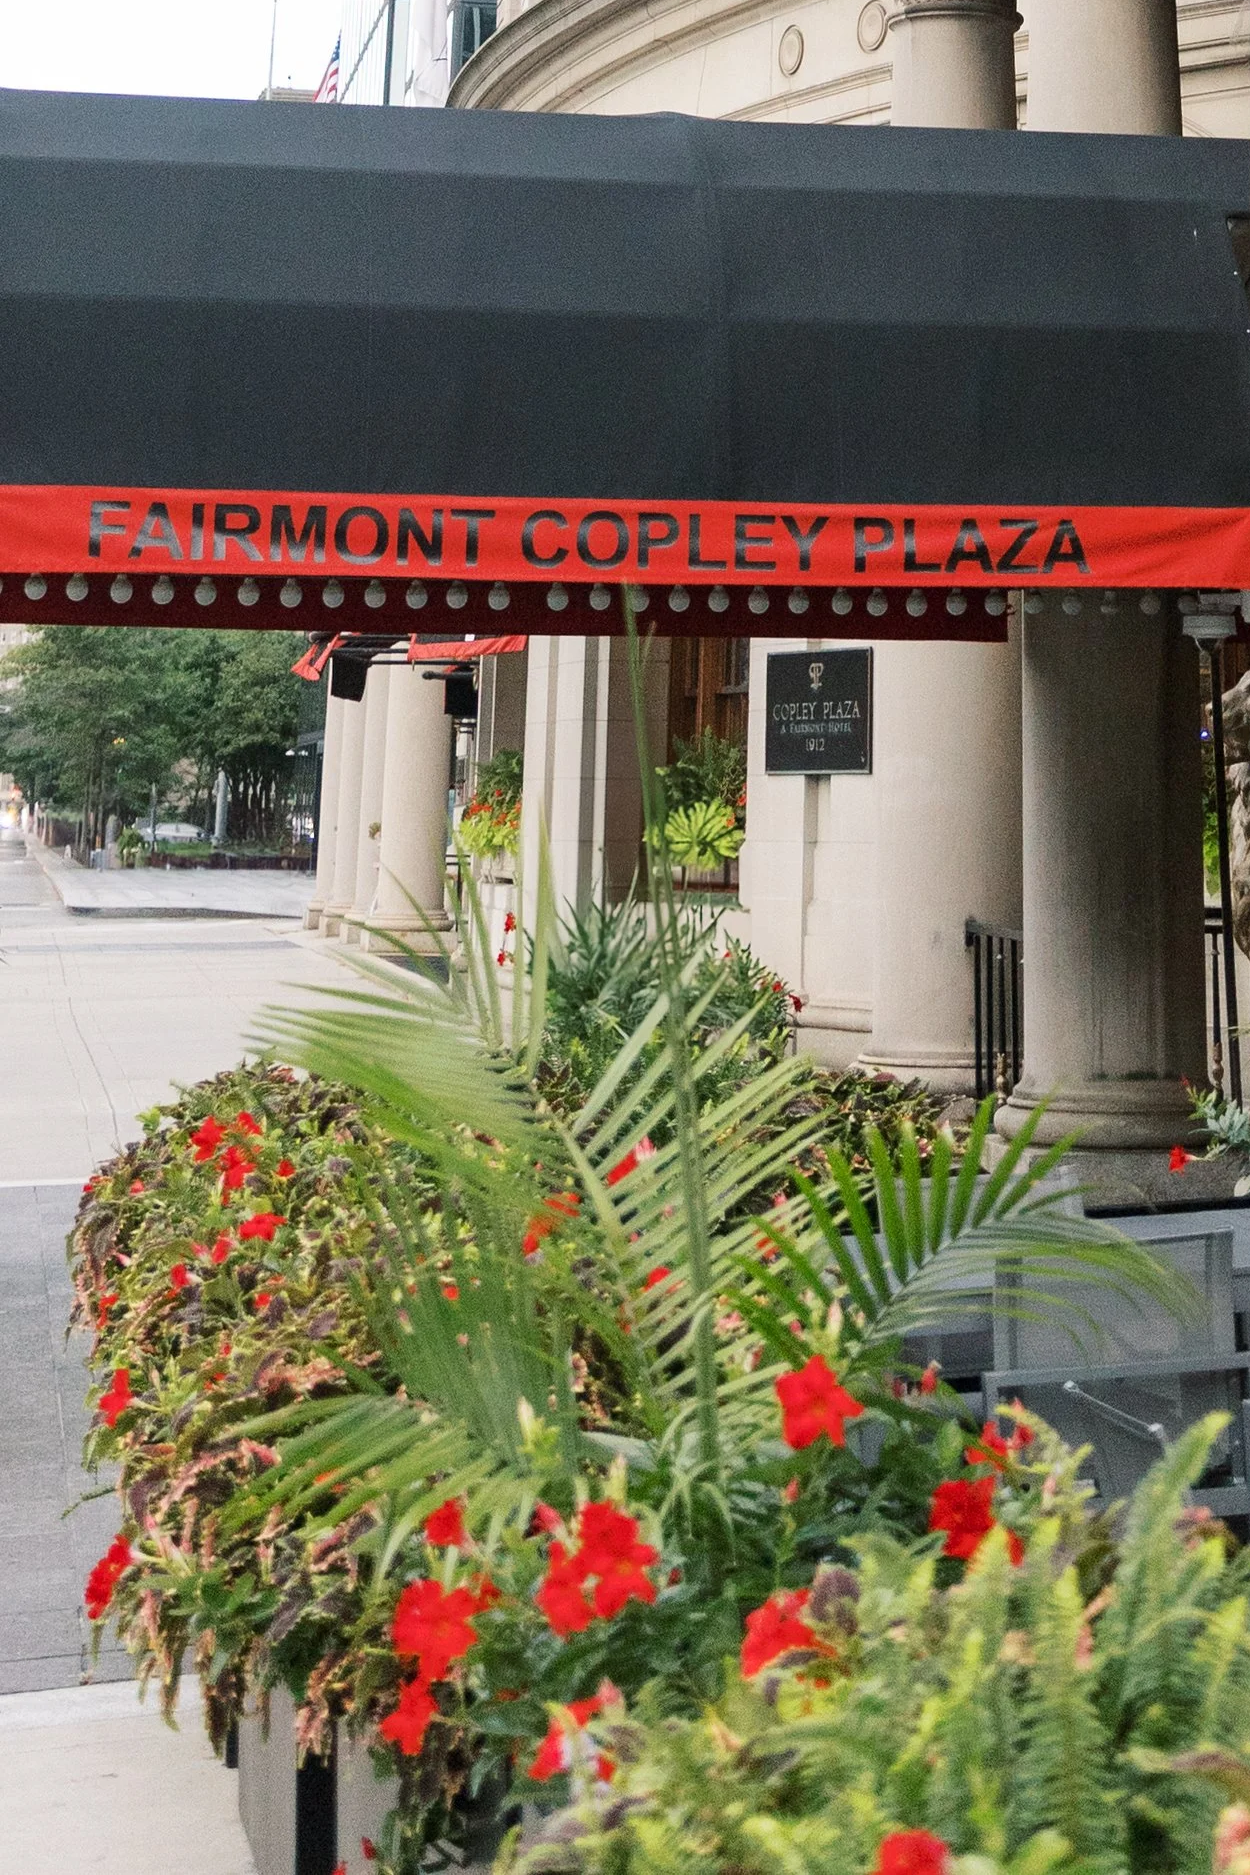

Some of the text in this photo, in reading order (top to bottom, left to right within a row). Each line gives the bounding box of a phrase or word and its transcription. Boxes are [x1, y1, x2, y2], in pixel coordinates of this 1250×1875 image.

[87, 499, 1093, 575] FAIRMONT COPLEY PLAZA
[773, 700, 861, 720] COPLEY PLAZA
[805, 738, 825, 751] 1912
